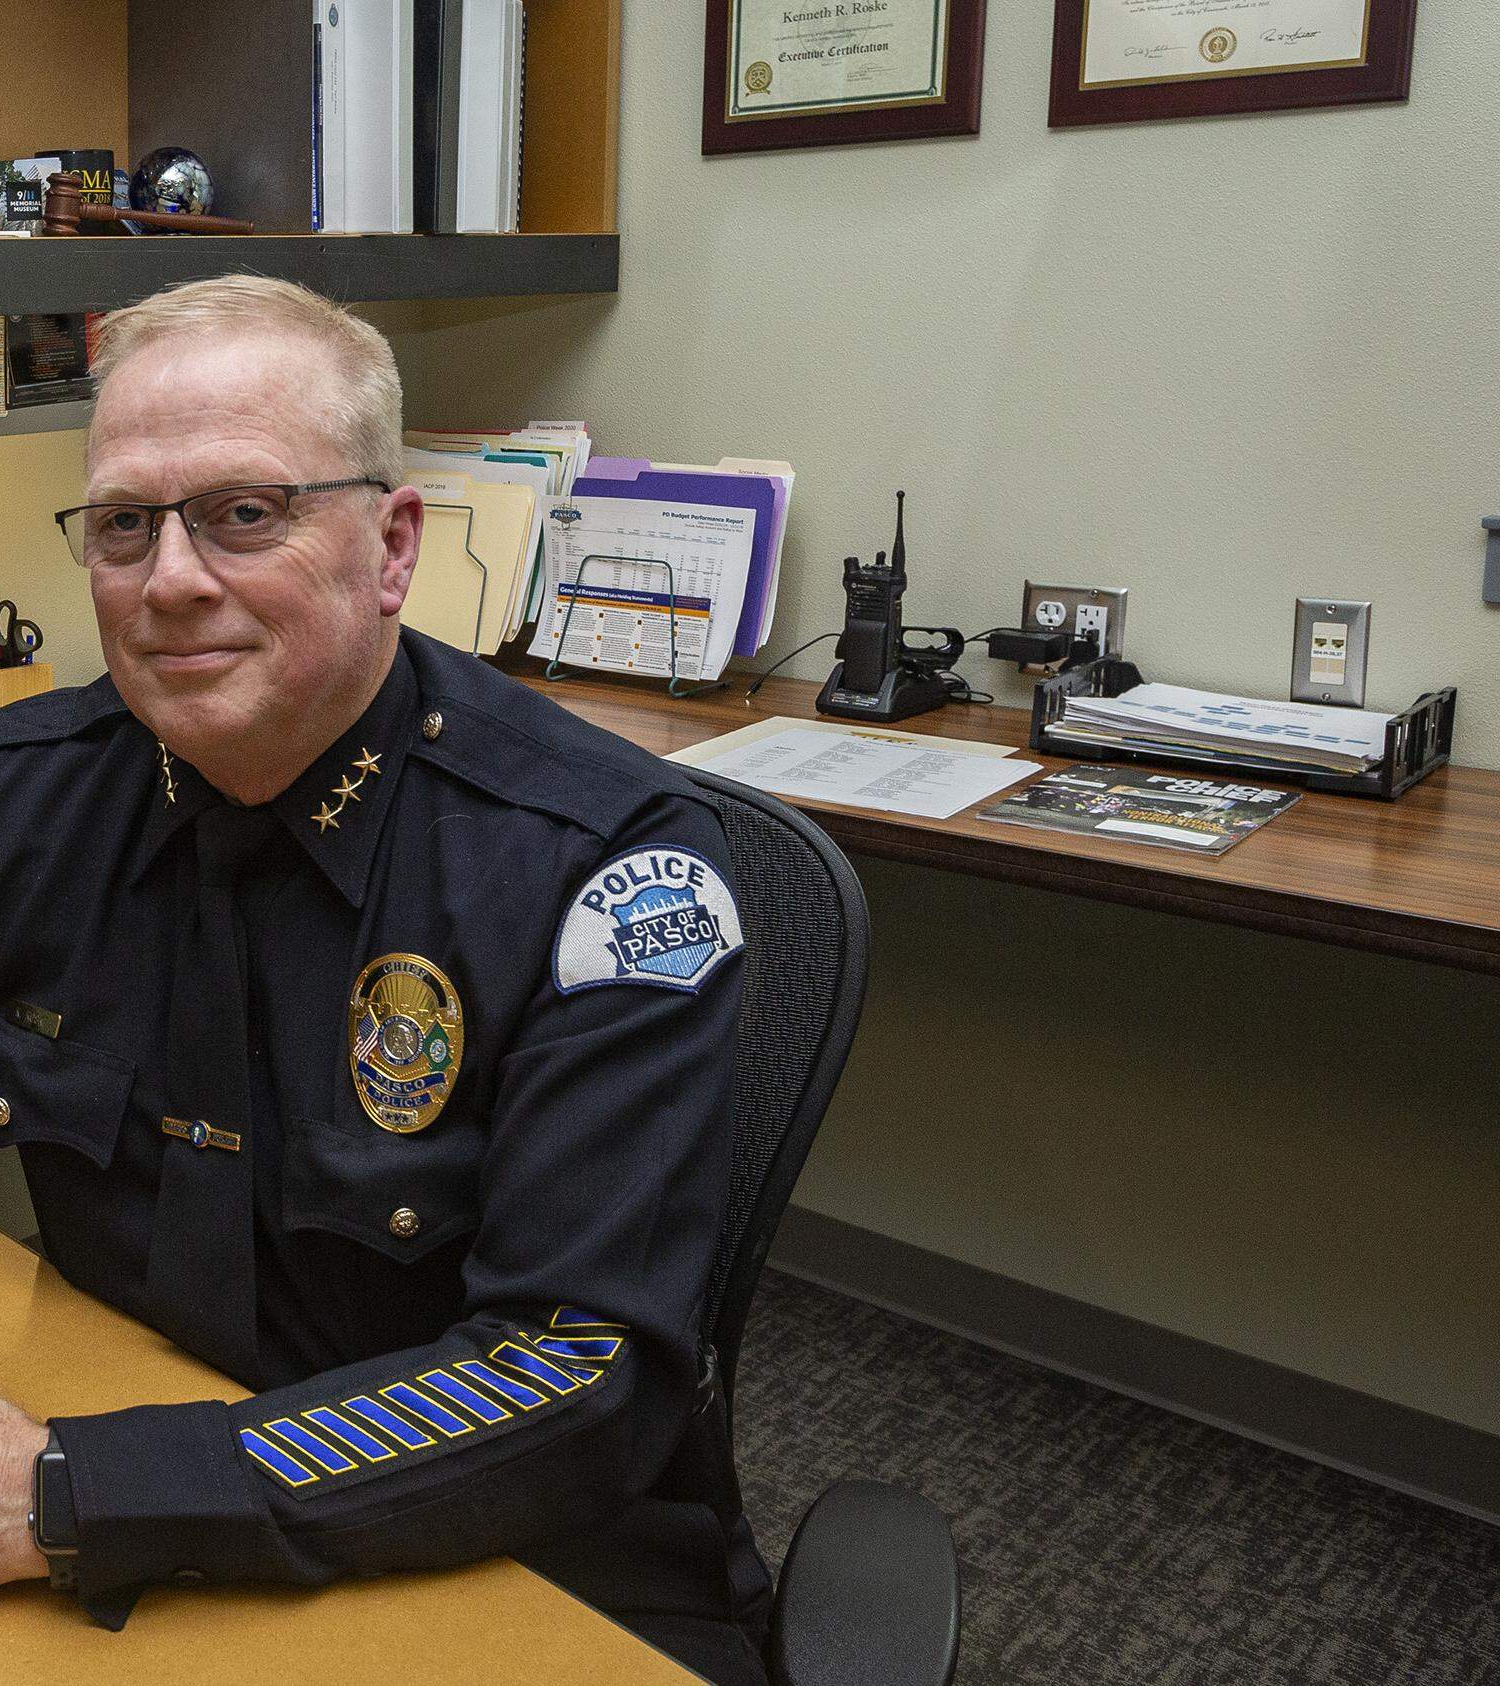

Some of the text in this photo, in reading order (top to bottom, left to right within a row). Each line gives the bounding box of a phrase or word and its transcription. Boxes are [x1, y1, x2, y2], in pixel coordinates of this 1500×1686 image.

[783, 0, 888, 23] Kenneth R. Roske
[779, 42, 889, 63] Executive Certification
[1146, 774, 1288, 799] POLICE
[581, 855, 706, 916] POLICE
[632, 910, 697, 937] CITY OF
[622, 920, 713, 960] PASCO
[374, 1073, 426, 1093] PASCO
[373, 1091, 424, 1107] POLICE
